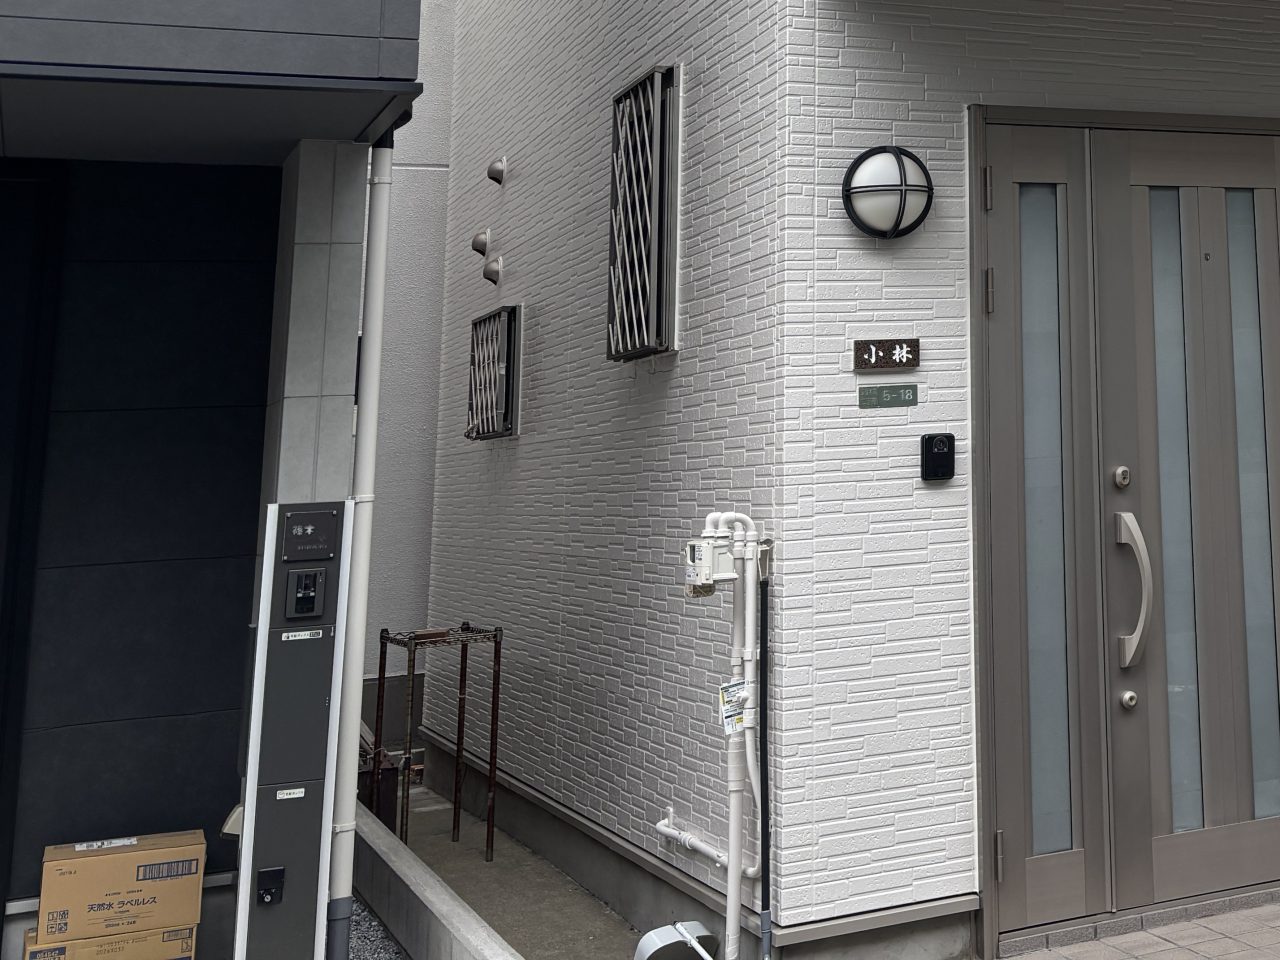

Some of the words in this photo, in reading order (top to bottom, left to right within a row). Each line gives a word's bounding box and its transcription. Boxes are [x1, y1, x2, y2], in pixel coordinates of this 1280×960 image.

[863, 343, 913, 364] 小林
[883, 389, 913, 401] 5-18
[87, 901, 115, 913] 天然水
[117, 896, 158, 909] ラベルレス
